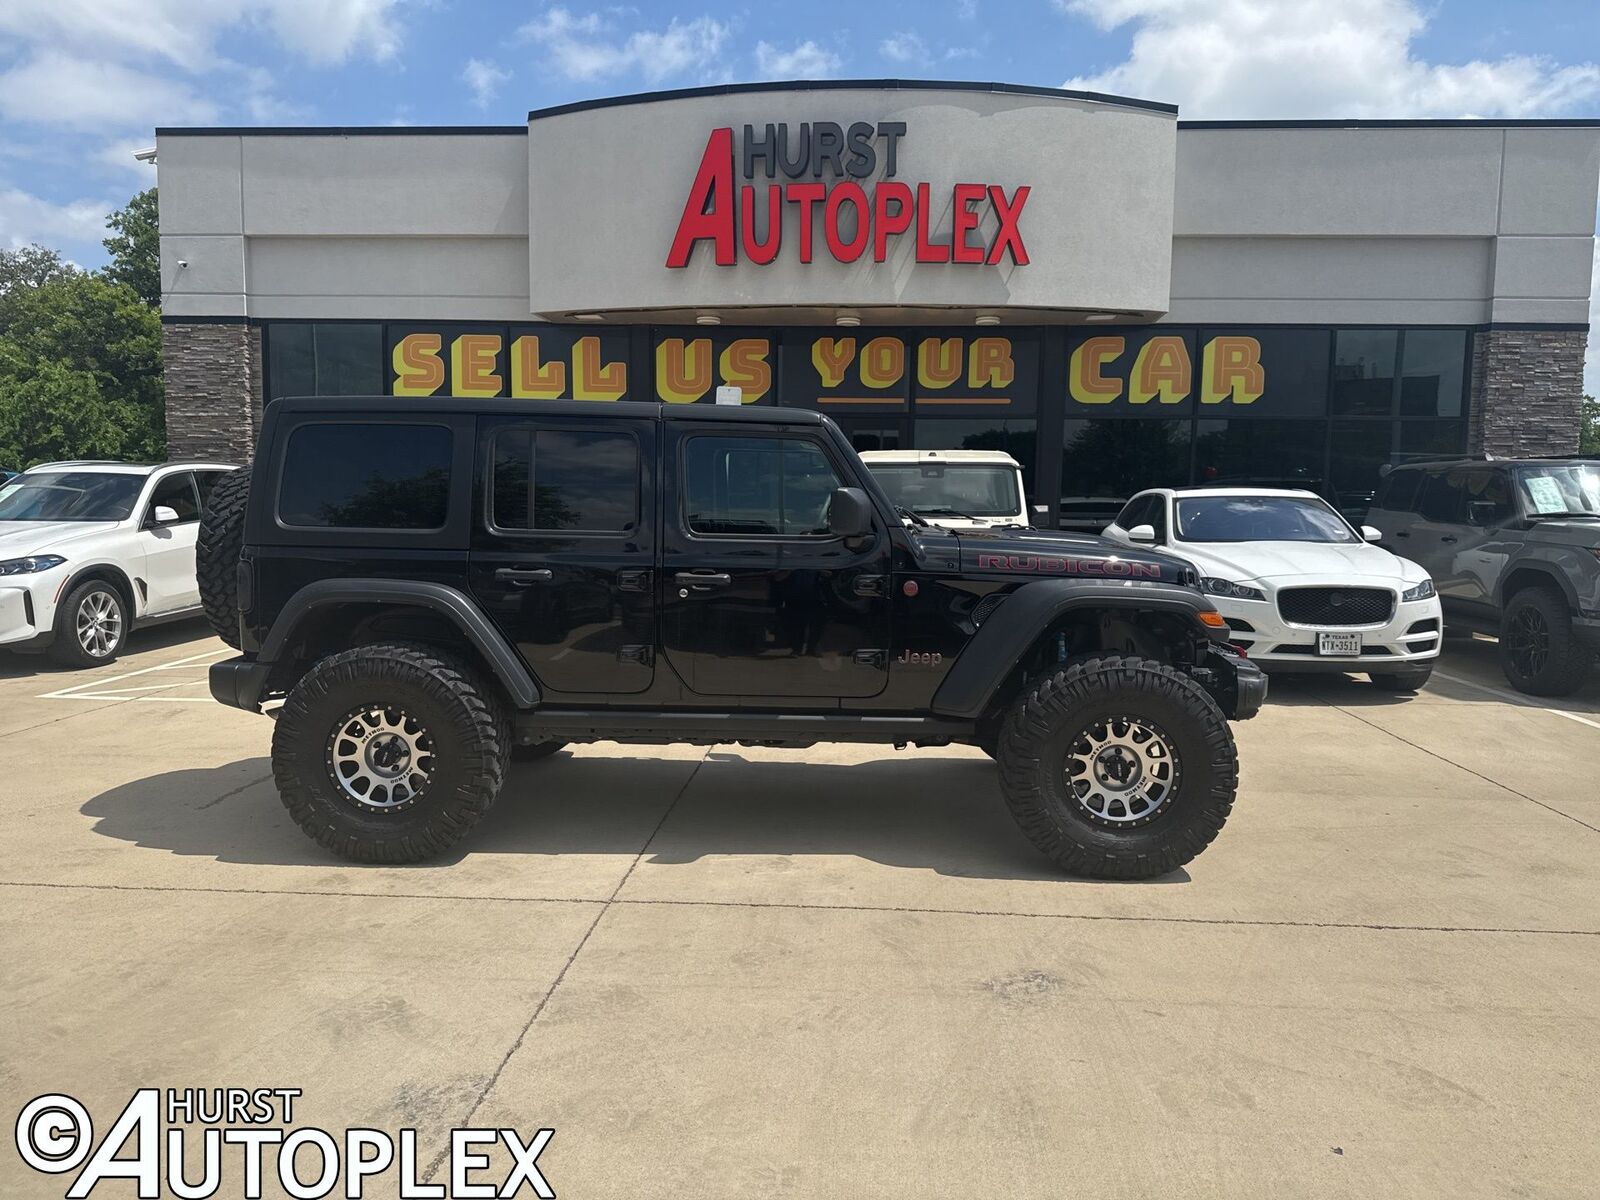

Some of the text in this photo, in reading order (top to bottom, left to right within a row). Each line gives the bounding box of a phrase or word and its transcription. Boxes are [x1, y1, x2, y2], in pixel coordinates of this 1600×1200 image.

[743, 121, 907, 179] HURST
[665, 127, 1032, 268] AUTOPLEX
[392, 333, 1265, 404] SELL US YOUR CAR
[978, 554, 1161, 578] RUBICON
[898, 650, 943, 666] Jeep
[361, 727, 385, 744] METHOD
[1089, 740, 1112, 761] METHOD
[1124, 775, 1147, 797] METHOD
